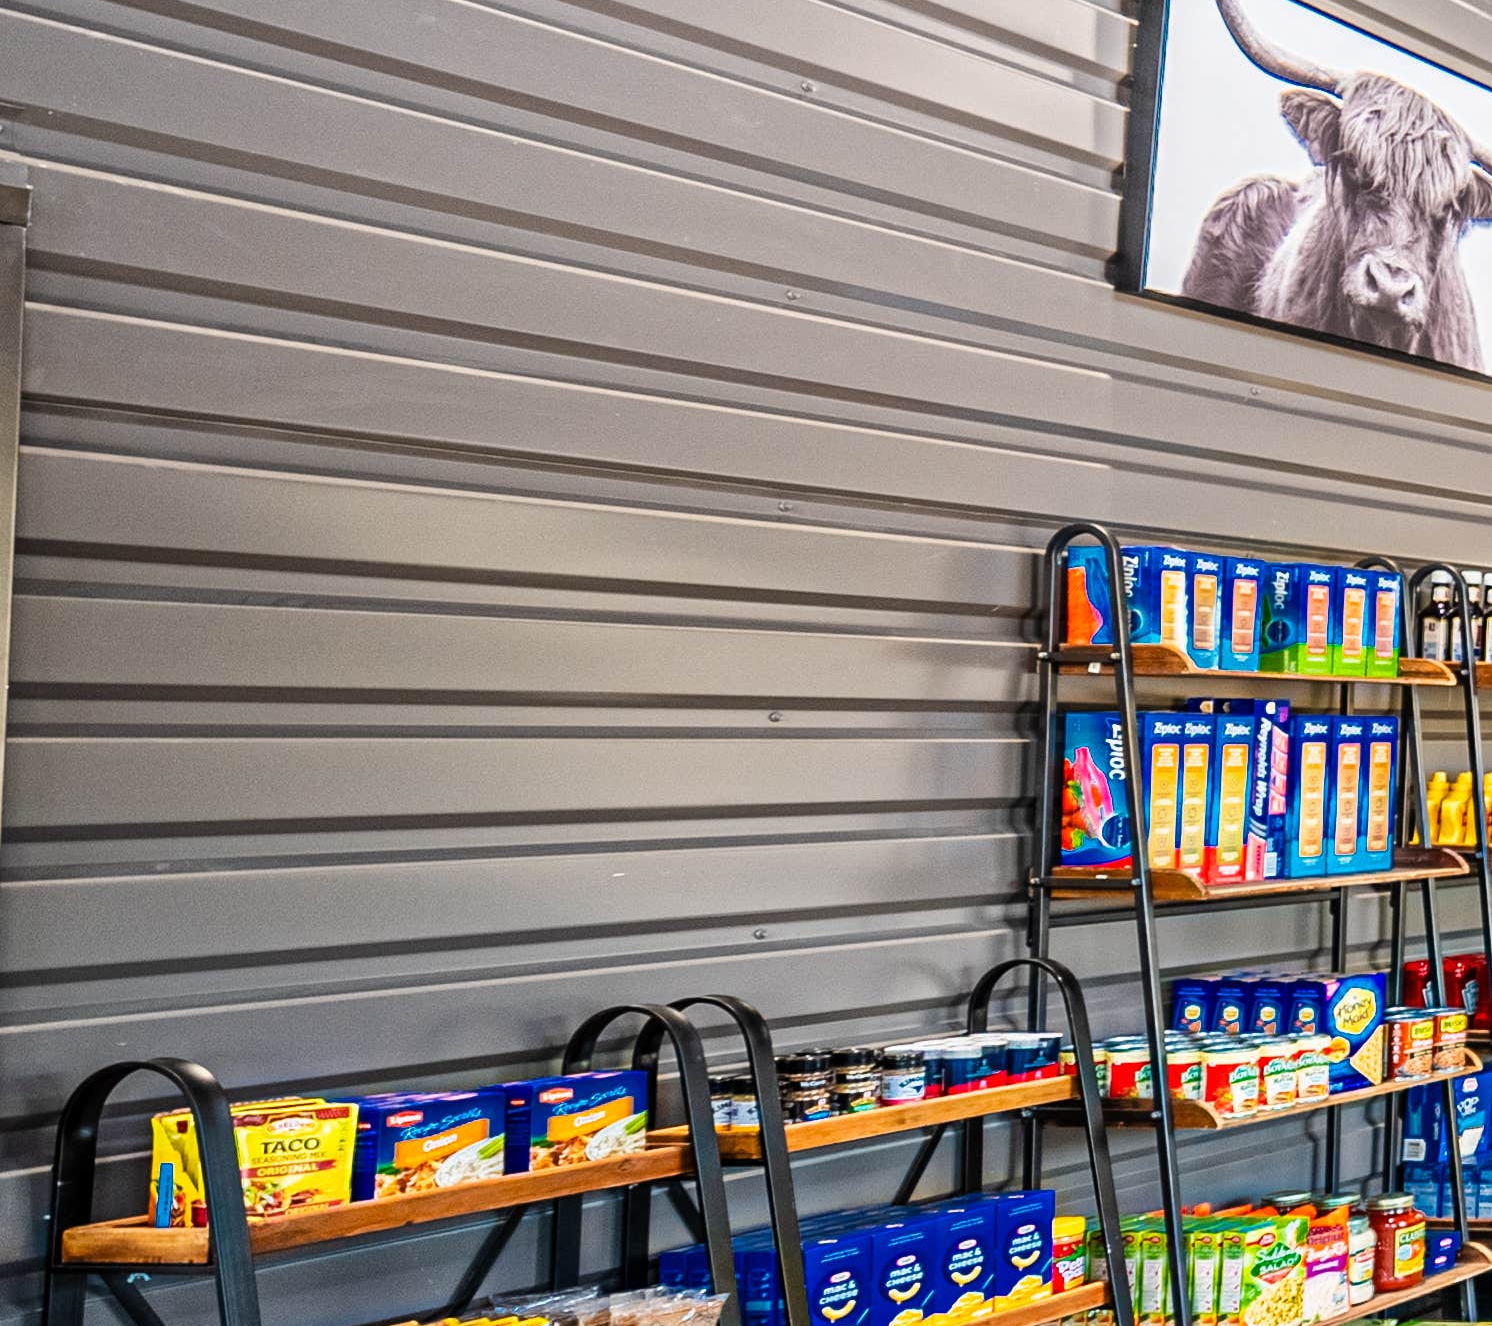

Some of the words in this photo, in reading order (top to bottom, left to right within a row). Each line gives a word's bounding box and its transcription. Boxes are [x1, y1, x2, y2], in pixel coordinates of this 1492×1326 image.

[1164, 555, 1186, 567] Ziploc
[1196, 559, 1219, 572] Ziploc
[1236, 564, 1259, 577] Ziploc
[1310, 571, 1330, 583] Ziploc
[1346, 574, 1366, 586] Ziploc
[1378, 577, 1397, 589] Ziploc
[1273, 571, 1290, 609] Ziploc
[1154, 722, 1181, 737] Ziploc
[1185, 722, 1211, 737] Ziploc
[1224, 723, 1251, 737] Ziploc
[1304, 723, 1328, 735] Ziploc
[1340, 724, 1363, 736] Ziploc
[1372, 723, 1393, 735] Ziploc
[1257, 717, 1273, 774] Reynolds
[1254, 777, 1268, 817] Wrap
[1337, 998, 1373, 1018] Honey
[1343, 1011, 1371, 1028] Maid
[573, 1109, 607, 1127] Onion
[262, 1137, 321, 1155] TACO
[422, 1133, 458, 1152] Onion
[256, 1162, 320, 1177] ORIGINAL
[1012, 1235, 1031, 1246] mac
[952, 1250, 973, 1262] mac
[889, 1266, 912, 1279] mac
[823, 1284, 846, 1296] mac
